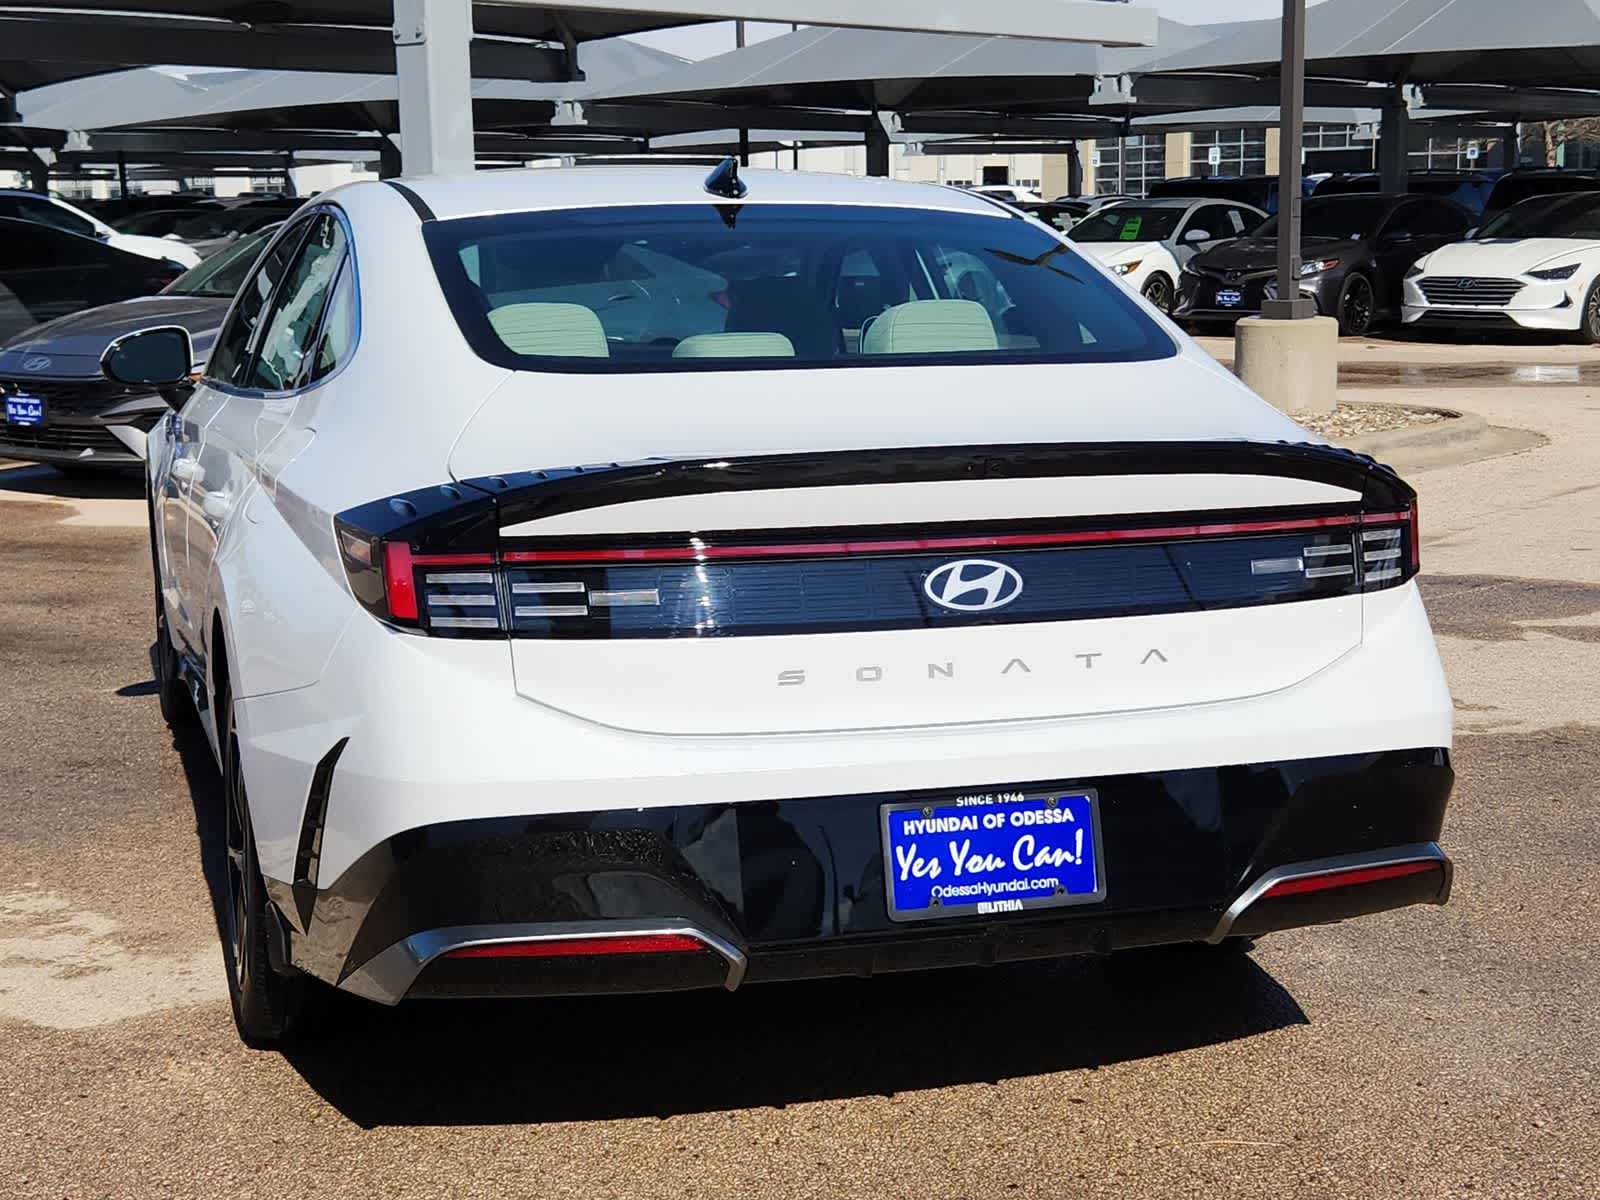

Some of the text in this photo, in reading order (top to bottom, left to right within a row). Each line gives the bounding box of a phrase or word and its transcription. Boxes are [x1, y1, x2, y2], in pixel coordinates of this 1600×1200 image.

[777, 648, 1168, 686] SONATA
[956, 792, 1025, 807] SINCE 1946
[903, 807, 1075, 836] HYUNDAI OF ODESSA
[895, 828, 1083, 881] Yes You Can!
[931, 877, 1060, 898] OdessaHyundai.com
